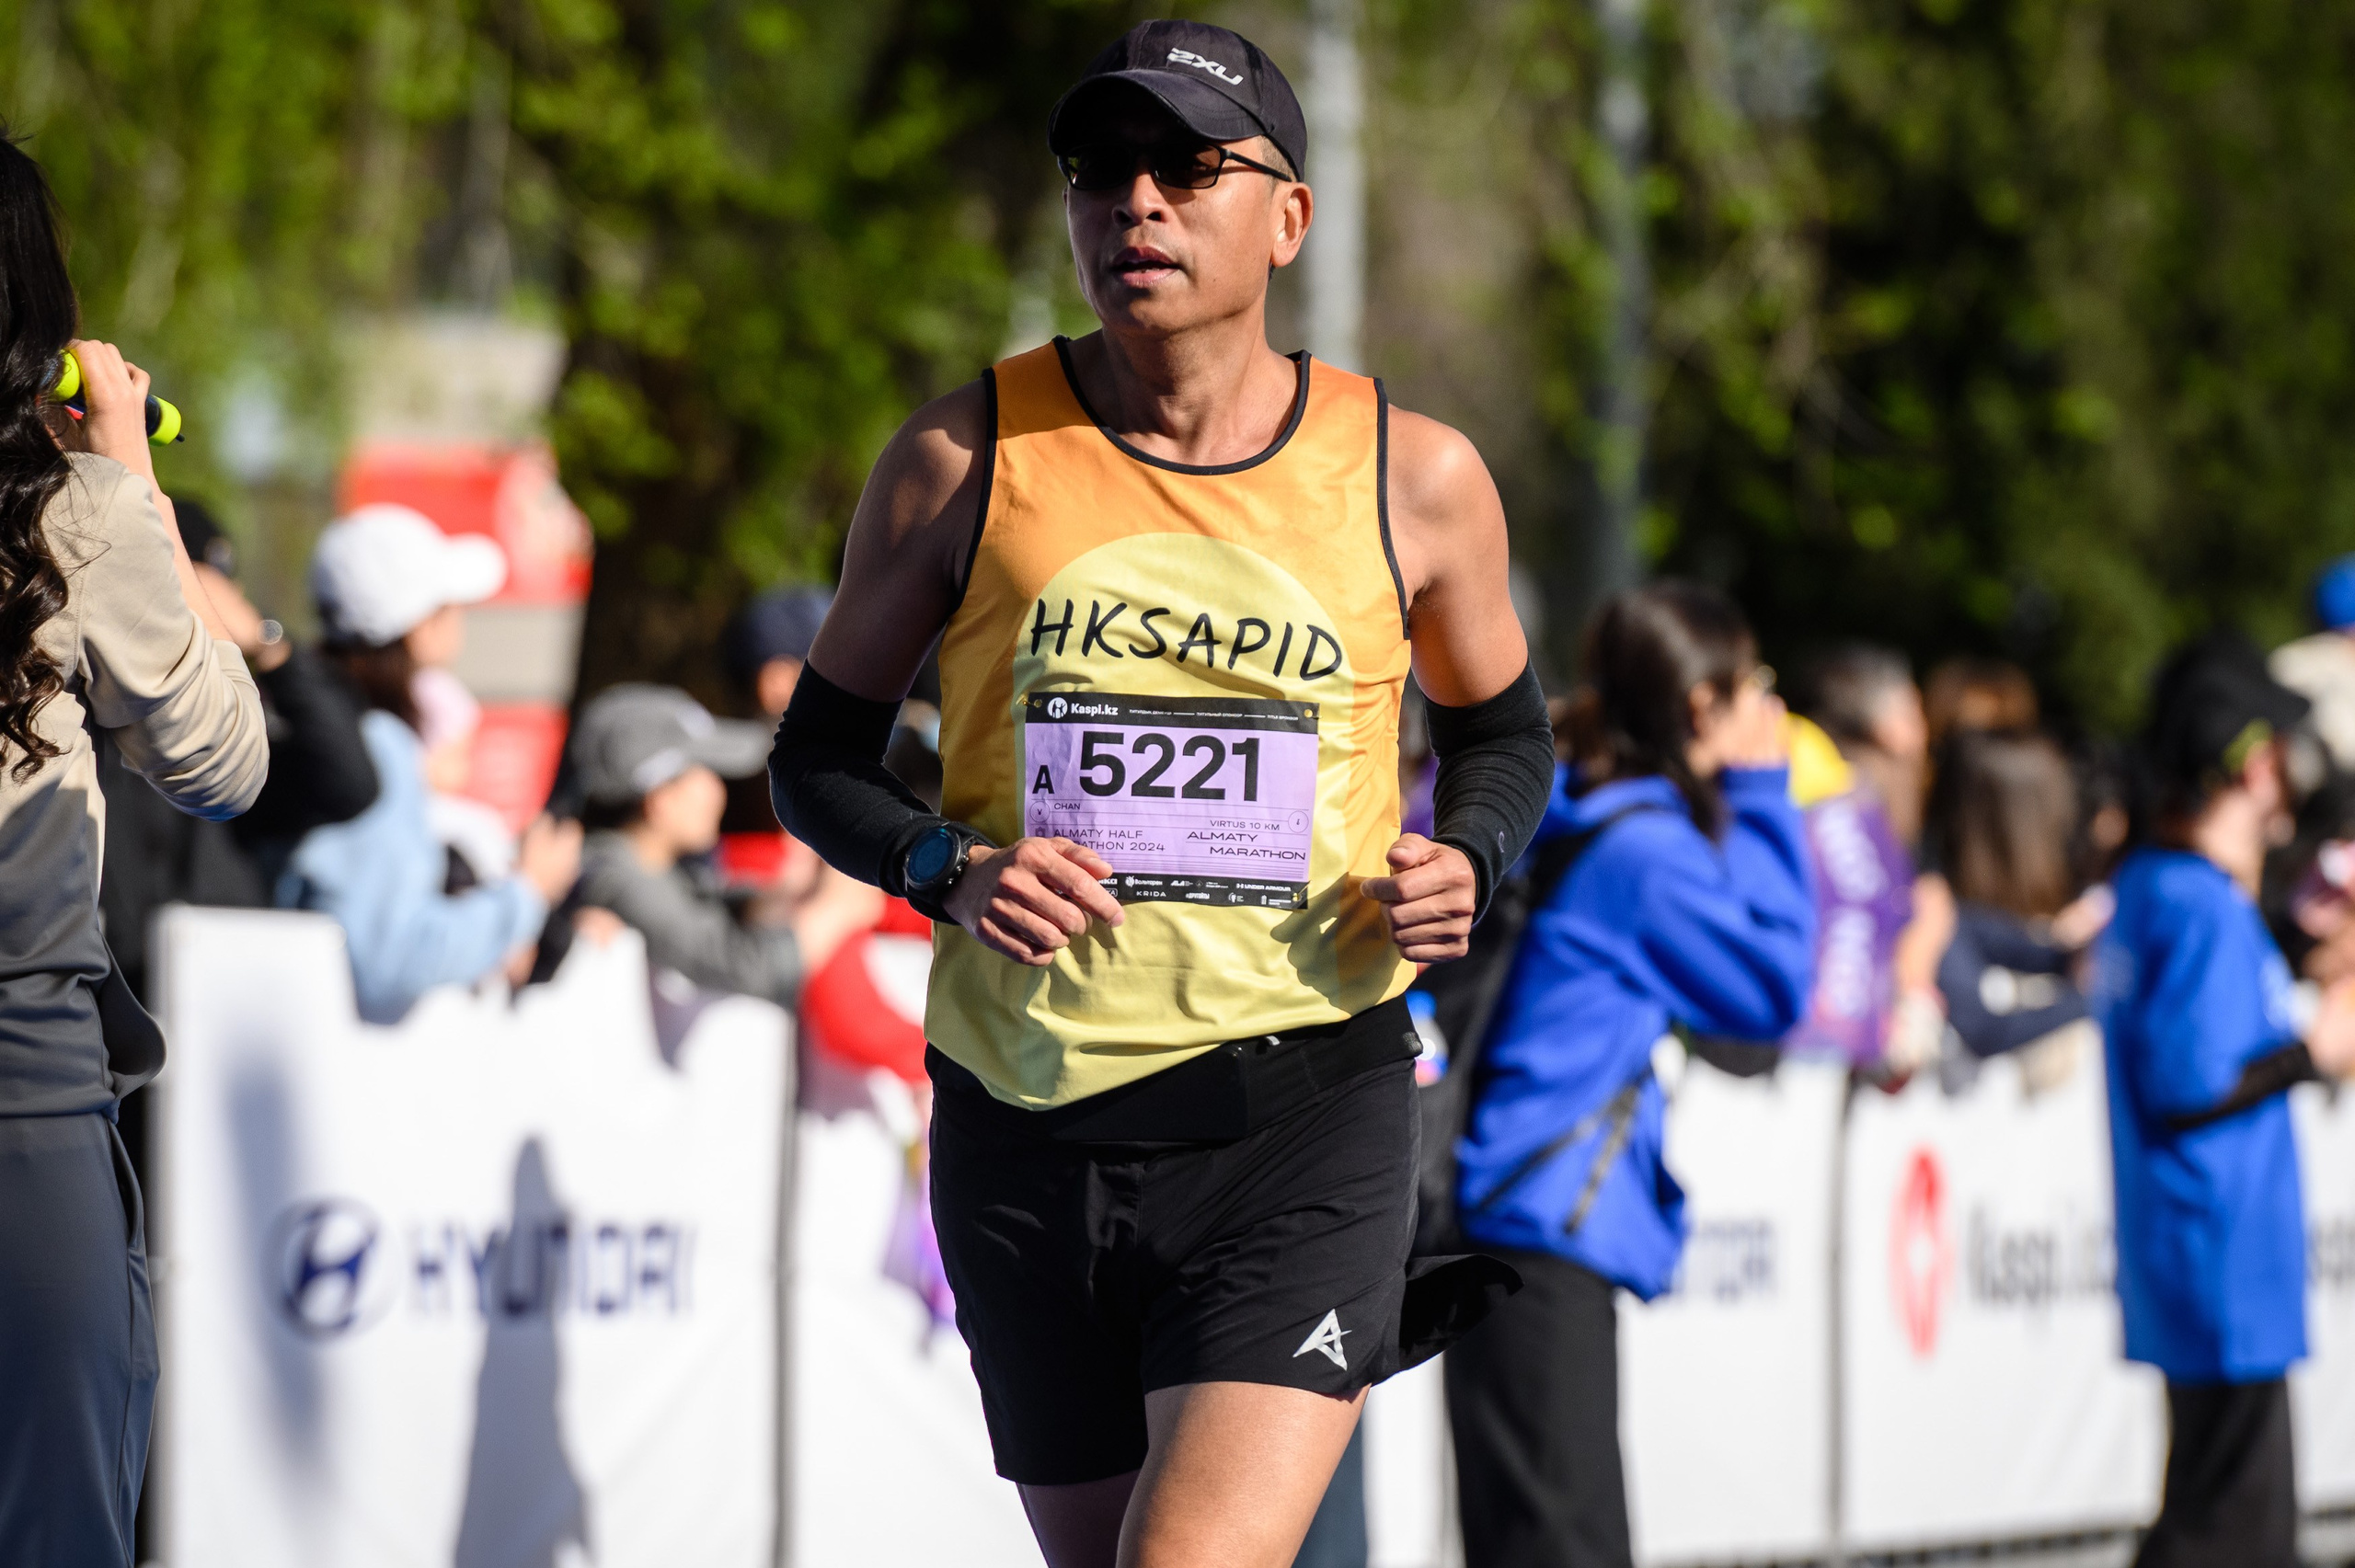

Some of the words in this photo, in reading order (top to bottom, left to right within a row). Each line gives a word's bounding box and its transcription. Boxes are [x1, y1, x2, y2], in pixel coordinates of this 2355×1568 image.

[1166, 47, 1244, 86] 2XU
[1029, 597, 1343, 681] HKSAPID
[1070, 703, 1119, 717] Kaspi.kz
[1079, 731, 1260, 802] 5221
[1032, 764, 1055, 795] A
[1053, 802, 1081, 810] CHAN
[1210, 819, 1246, 829] VIRTUS
[1264, 823, 1281, 831] KM
[1053, 829, 1104, 838] ALMATY
[1109, 830, 1143, 839] HALF
[1187, 830, 1258, 842] ALMATY
[1130, 841, 1166, 852] 2024
[1210, 846, 1306, 861] MARATHON
